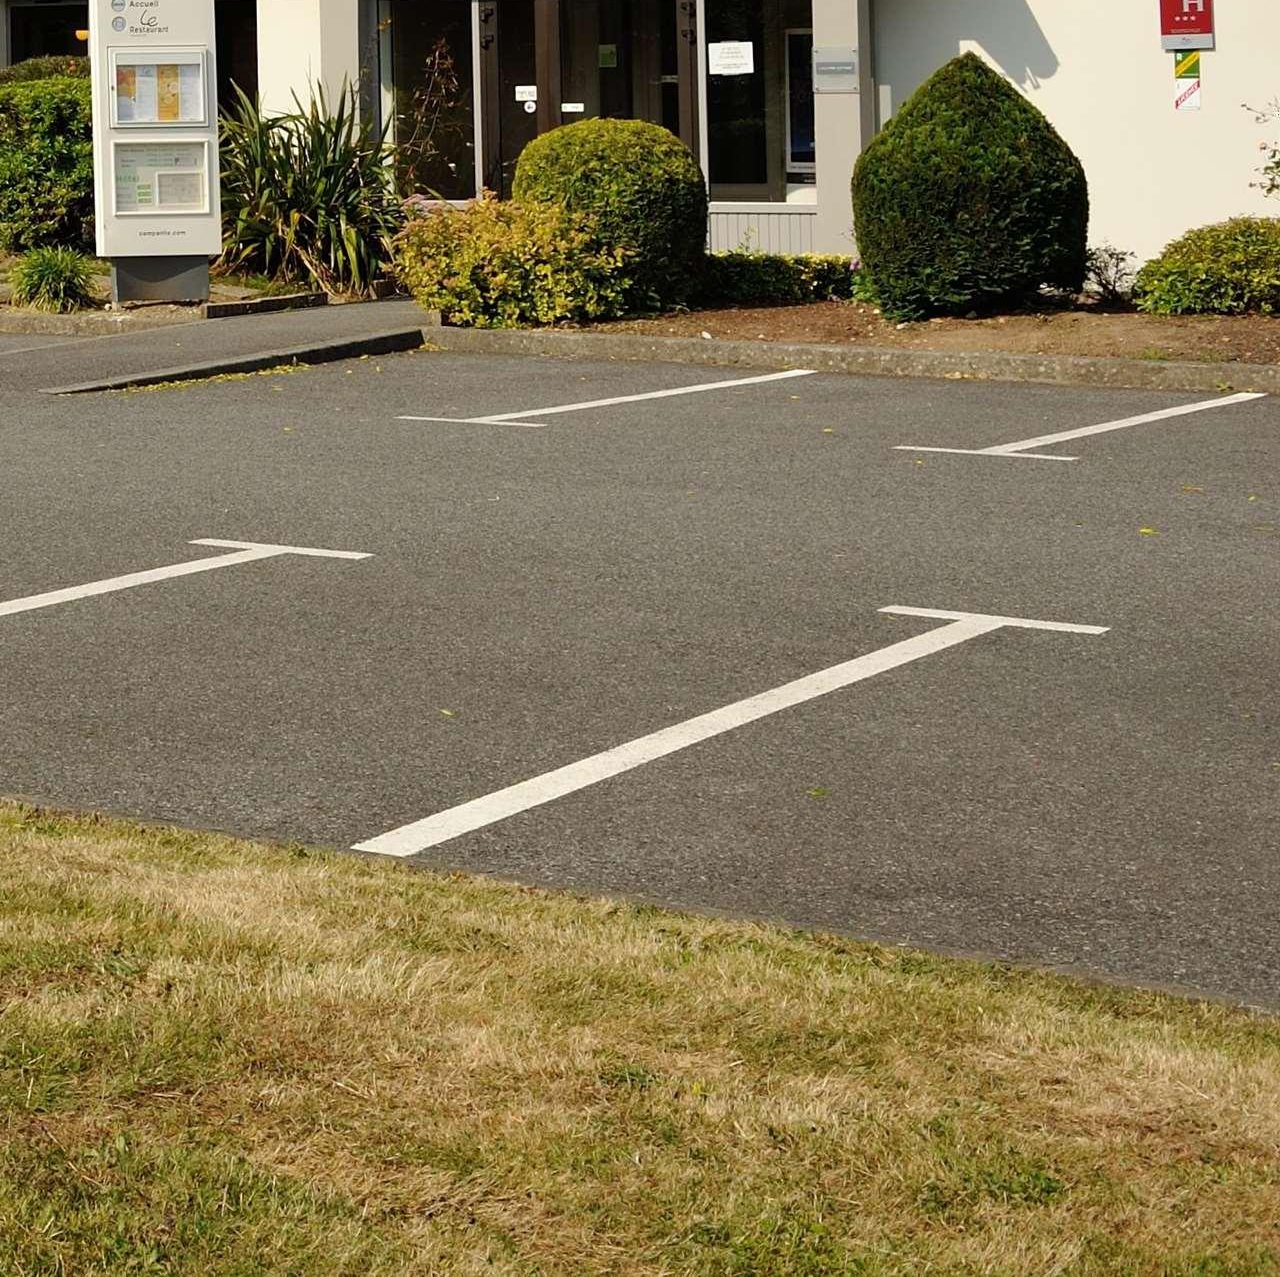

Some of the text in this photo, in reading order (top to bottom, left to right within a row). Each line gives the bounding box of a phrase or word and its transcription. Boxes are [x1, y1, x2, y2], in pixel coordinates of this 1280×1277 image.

[129, 0, 159, 8] Accueil
[139, 9, 158, 27] Le
[129, 26, 169, 34] Restaurant
